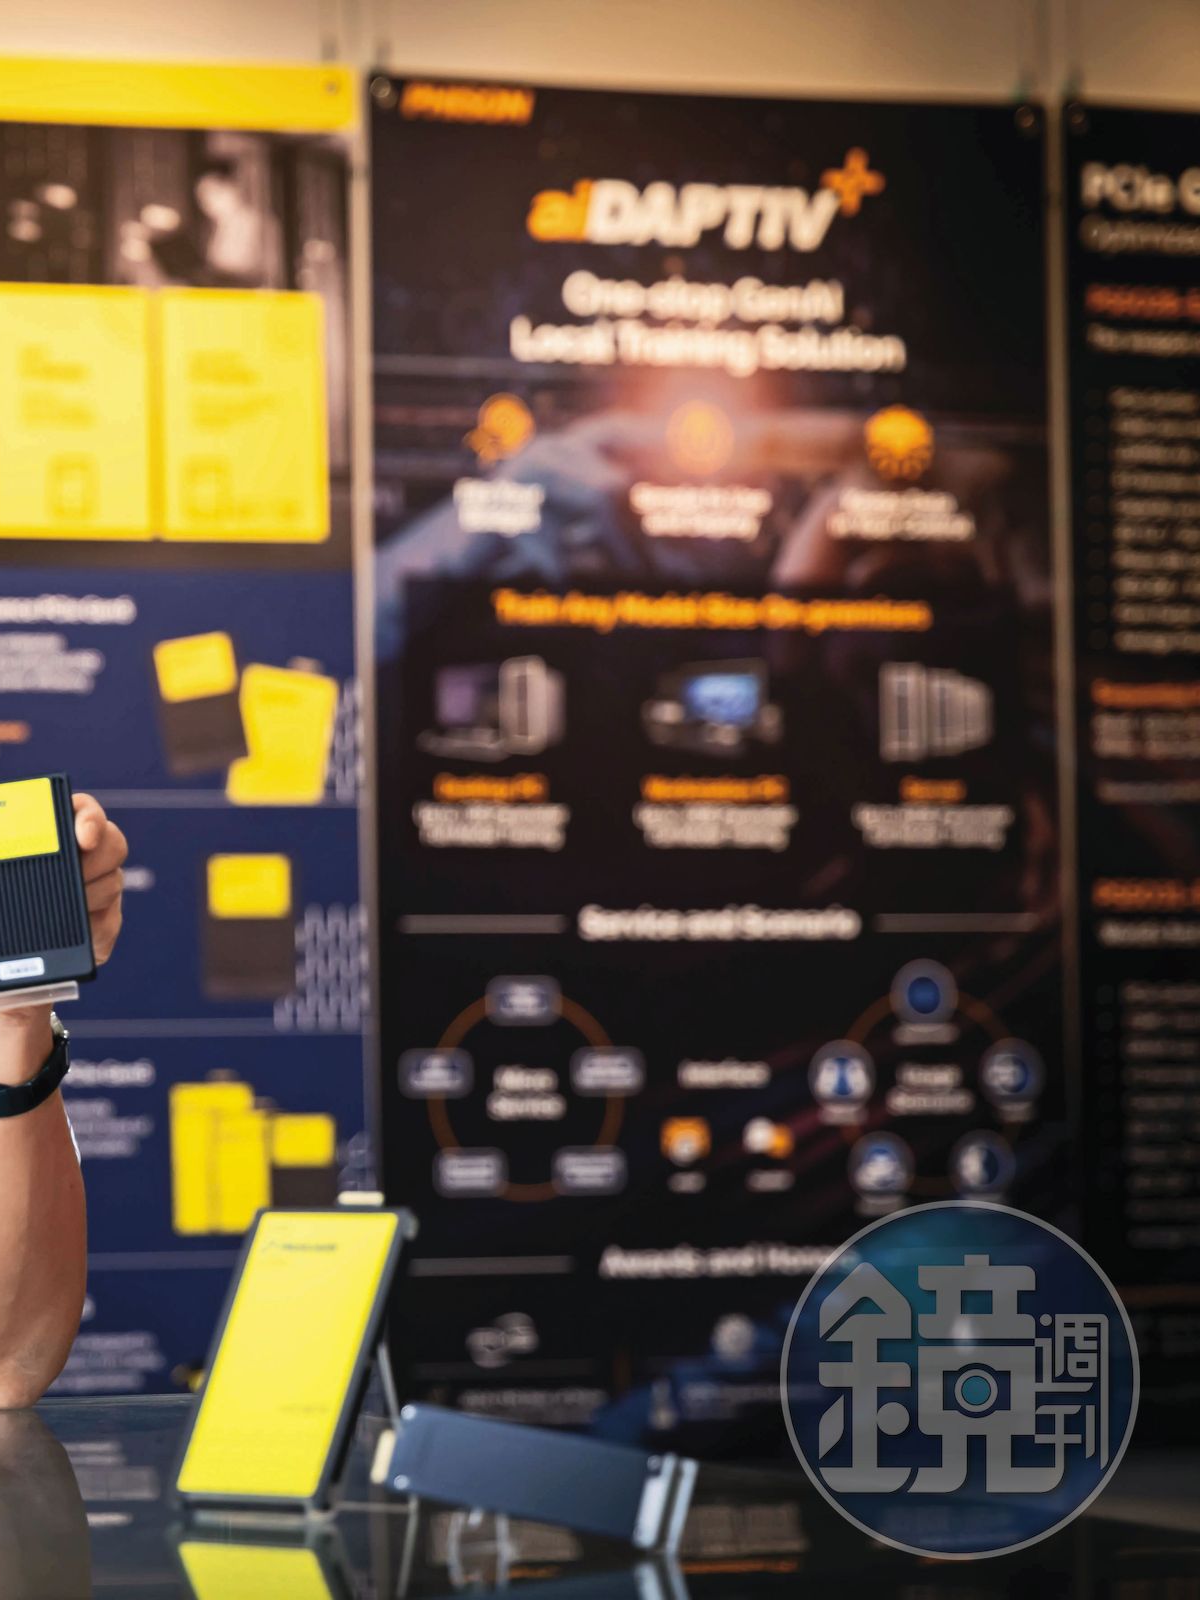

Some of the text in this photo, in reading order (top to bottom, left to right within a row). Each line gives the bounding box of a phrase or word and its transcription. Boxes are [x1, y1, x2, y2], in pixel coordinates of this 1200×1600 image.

[563, 271, 731, 325] One-stop
[511, 316, 906, 376] Local Training Solution
[579, 904, 682, 941] Service
[684, 905, 735, 940] and
[600, 1245, 702, 1278] Awards
